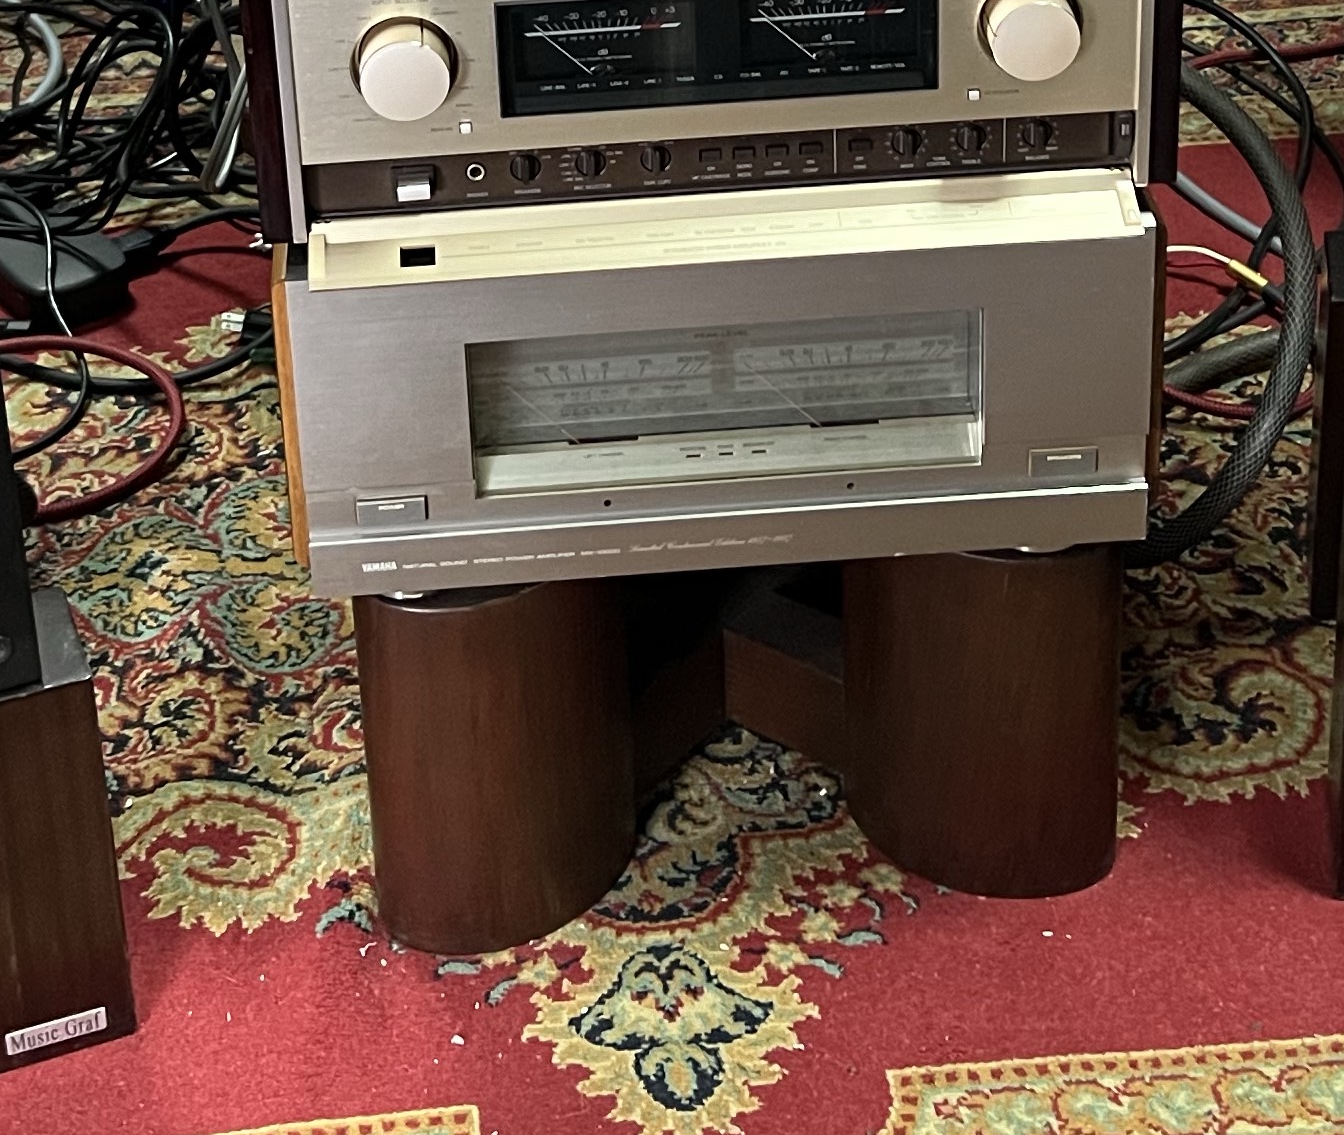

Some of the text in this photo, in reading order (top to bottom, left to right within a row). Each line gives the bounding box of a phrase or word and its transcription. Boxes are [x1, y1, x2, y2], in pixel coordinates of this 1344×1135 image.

[362, 560, 397, 572] YAMAHA
[10, 1011, 102, 1053] Music Graf
